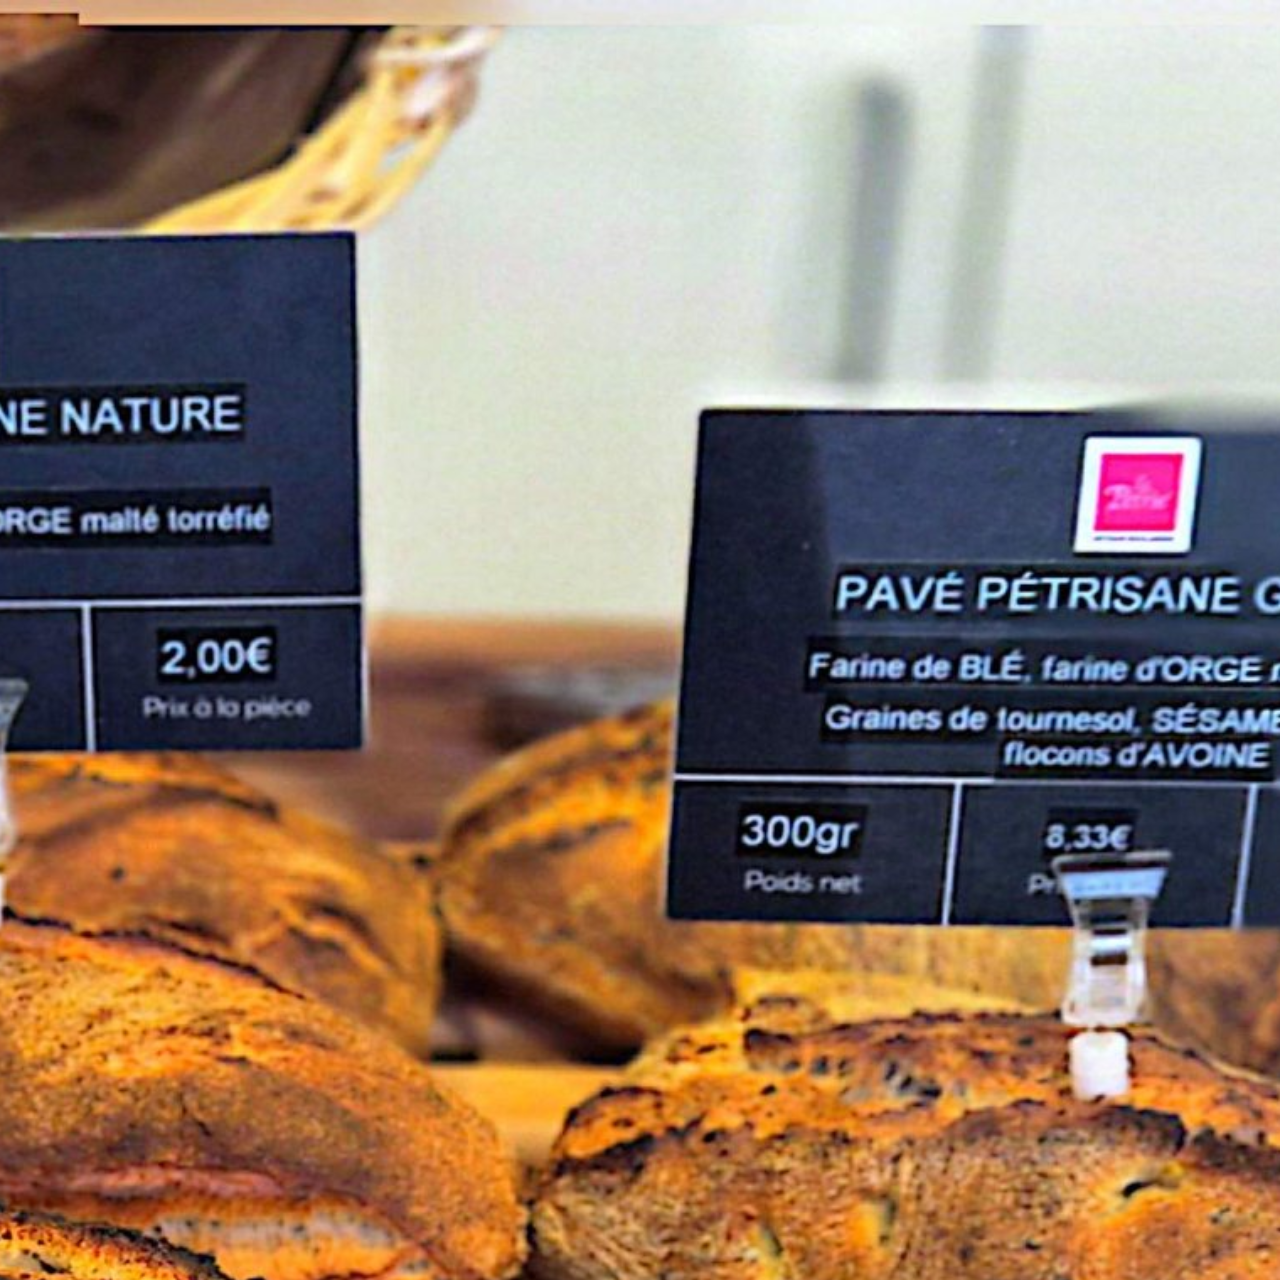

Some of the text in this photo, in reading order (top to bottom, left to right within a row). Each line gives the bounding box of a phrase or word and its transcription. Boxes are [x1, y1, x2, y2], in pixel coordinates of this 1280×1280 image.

[60, 396, 242, 435] NATURE
[80, 505, 159, 533] malté
[166, 503, 270, 533] torréfié
[836, 571, 965, 612] PAVÉ
[976, 571, 1241, 613] PÉTRISANE
[160, 636, 272, 679] 2,00€
[808, 652, 906, 680] Farine
[912, 654, 952, 680] de
[958, 650, 1032, 683] BLÉ,
[1041, 654, 1128, 682] farine
[1135, 655, 1263, 683] d'ORGE
[142, 697, 188, 718] Prix
[825, 704, 943, 731] Graines
[948, 706, 989, 731] de
[1003, 740, 1270, 769] flocons d'AVOINE
[742, 814, 860, 854] 300gr
[743, 868, 862, 893] Poids net
